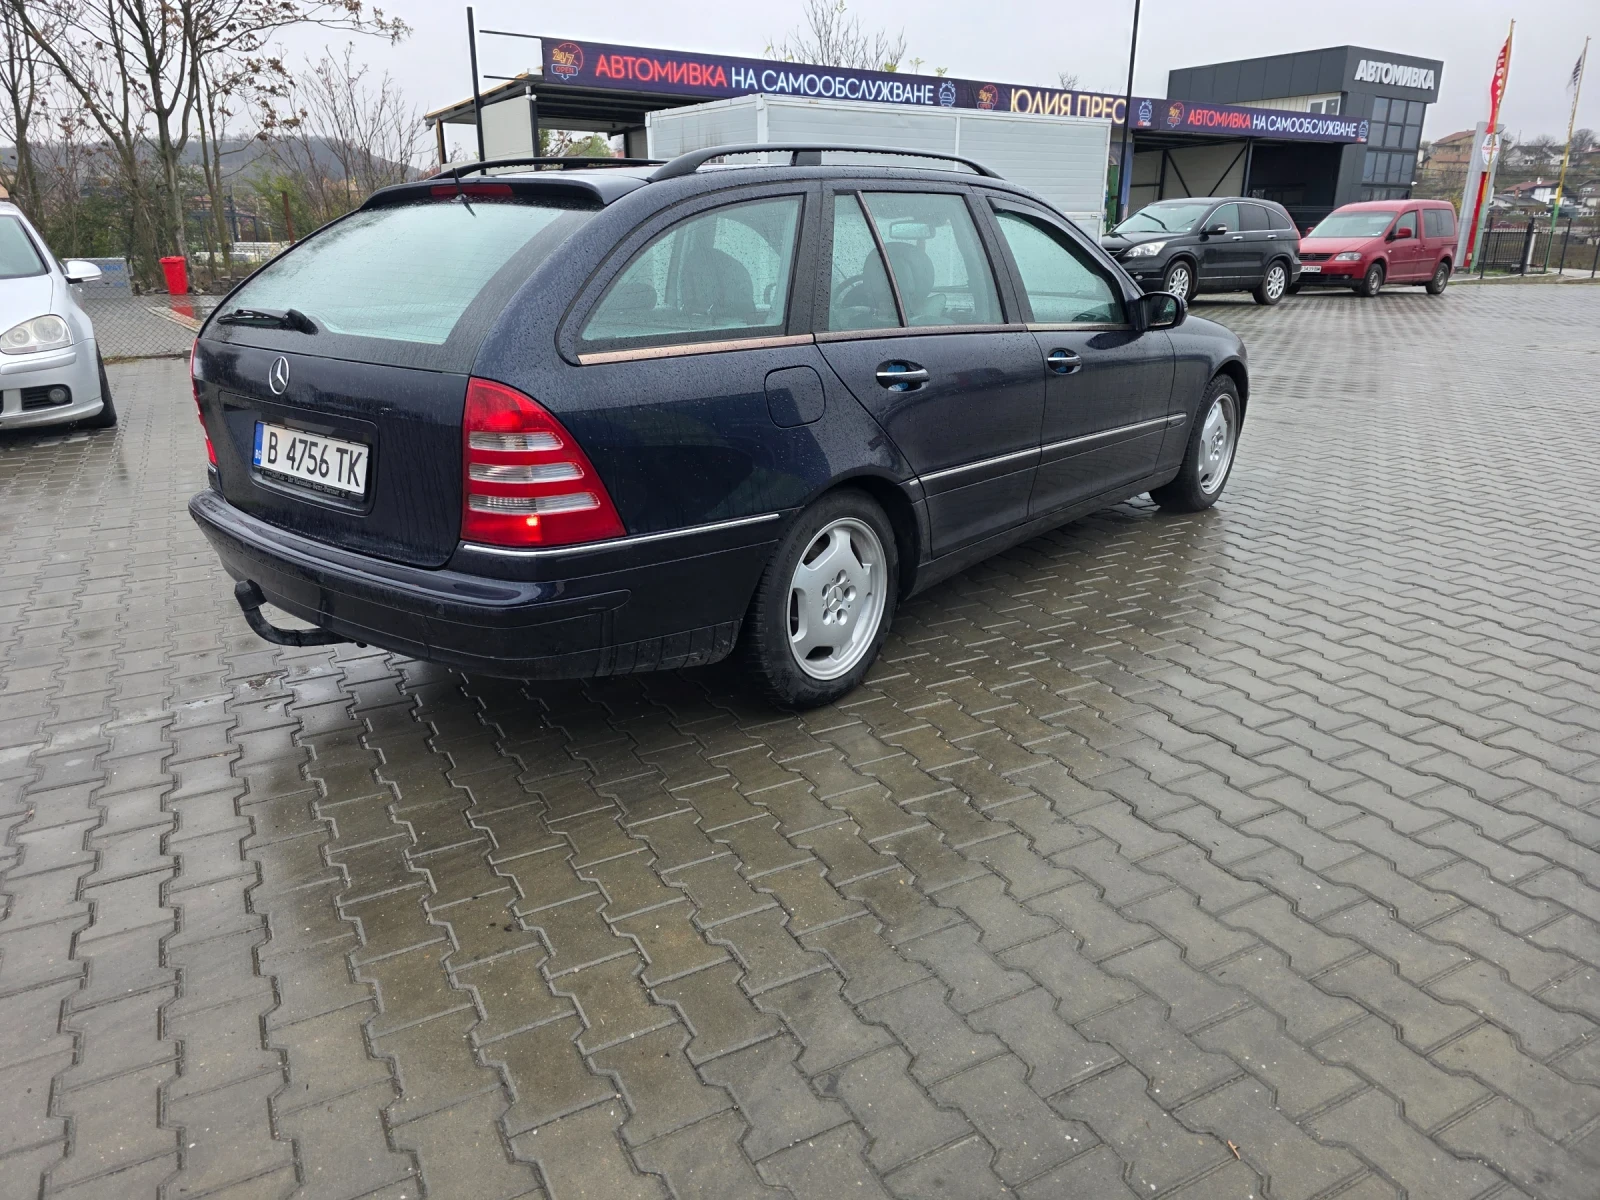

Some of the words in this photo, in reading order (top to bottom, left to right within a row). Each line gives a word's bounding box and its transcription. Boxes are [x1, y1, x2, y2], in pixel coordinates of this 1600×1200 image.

[555, 66, 575, 74] OPEN
[595, 54, 728, 88] АВТОМИВКА
[731, 66, 758, 89] НА
[761, 69, 935, 105] САМООБСЛУЖВАНЕ
[1354, 59, 1435, 90] АВТОМИВКА
[1010, 88, 1072, 116] ЮЛИЯ
[1187, 109, 1251, 129] АВТОМИВКА
[1252, 114, 1267, 130] НА
[1267, 115, 1358, 137] САМООБСЛУЖВАНЕ
[268, 431, 278, 464] B
[286, 437, 330, 478] 4756
[336, 447, 363, 488] TK
